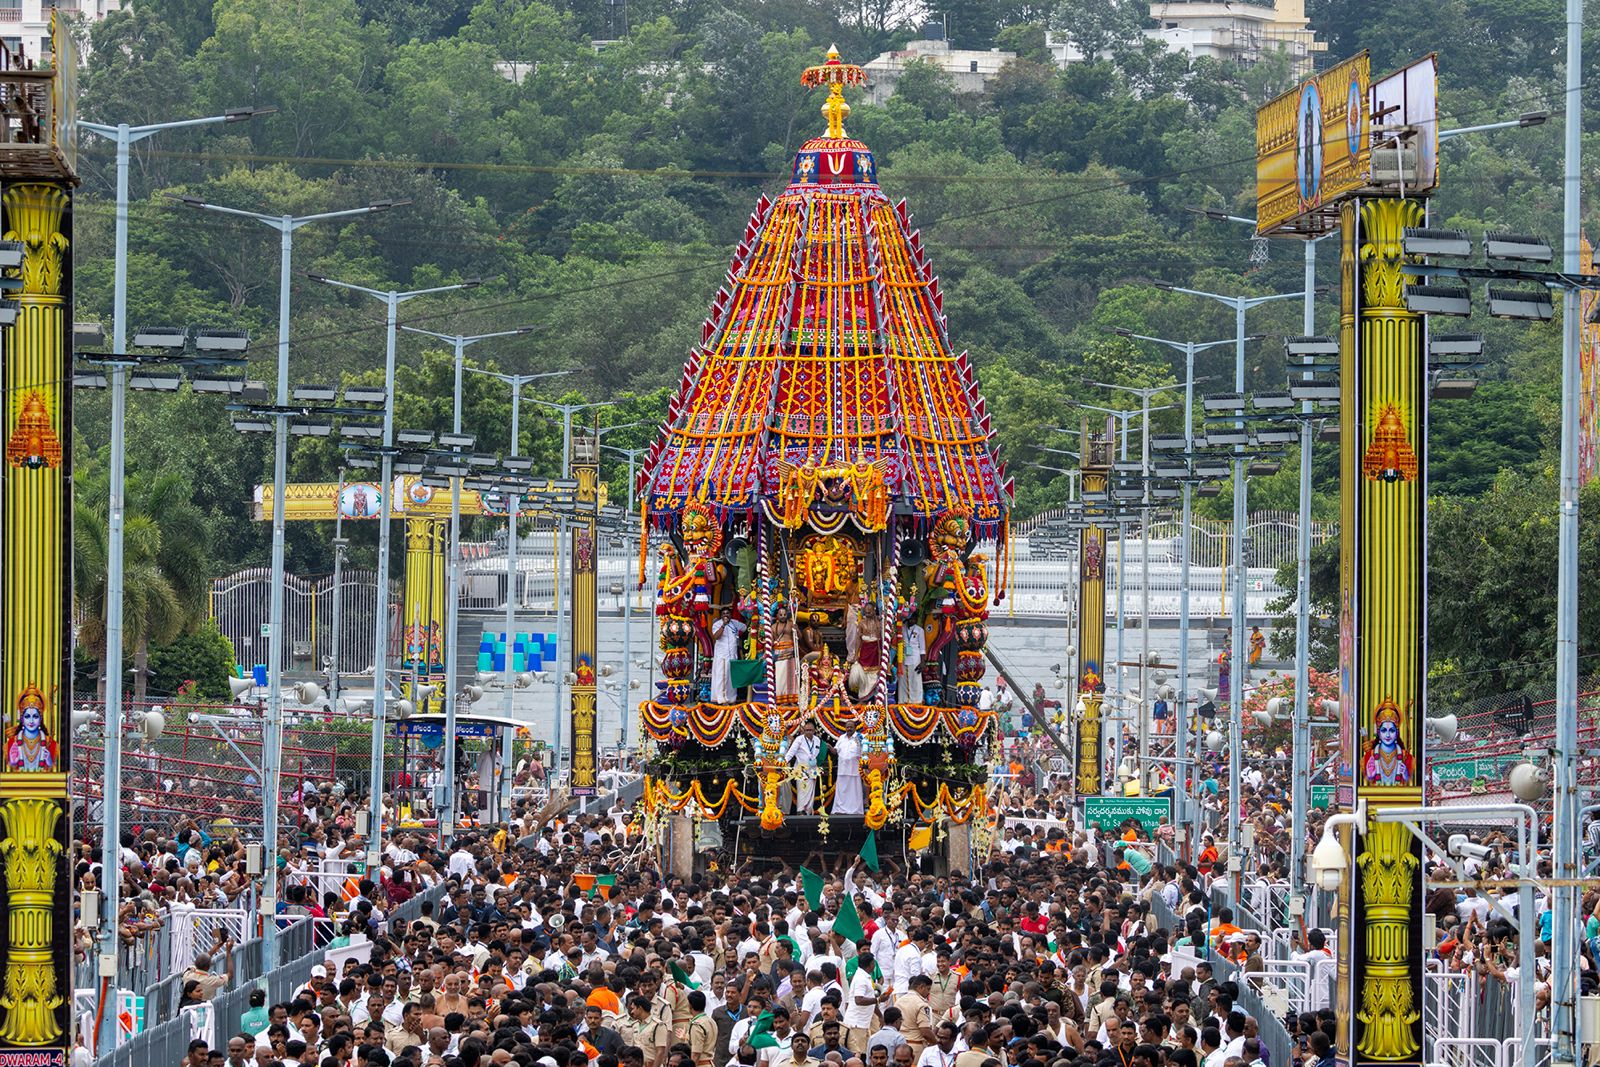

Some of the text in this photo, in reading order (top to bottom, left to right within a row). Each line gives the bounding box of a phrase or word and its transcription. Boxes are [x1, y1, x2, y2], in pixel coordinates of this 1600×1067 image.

[1154, 807, 1168, 815] దారి
[1103, 819, 1110, 827] To
[0, 1053, 51, 1066] DWARAM
